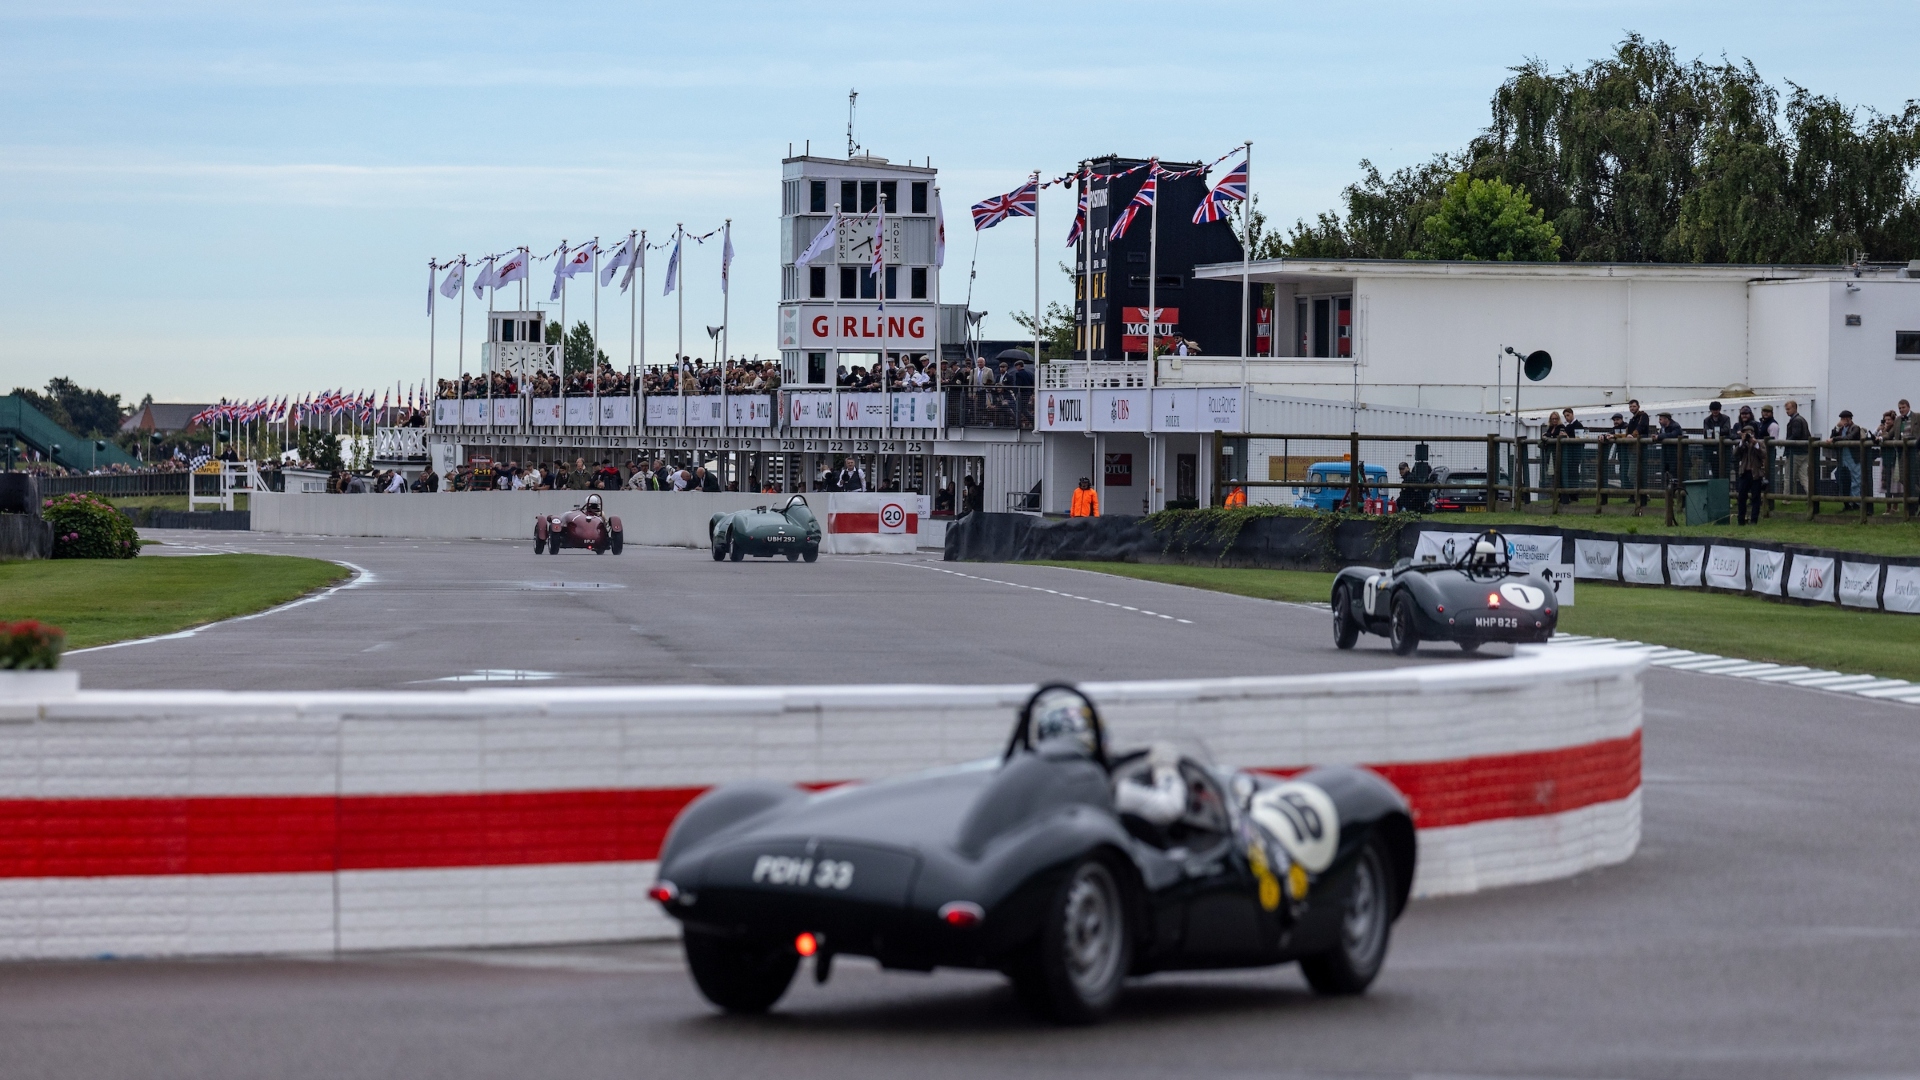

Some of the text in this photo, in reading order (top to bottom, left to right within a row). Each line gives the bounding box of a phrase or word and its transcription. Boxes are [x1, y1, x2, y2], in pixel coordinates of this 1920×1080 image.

[817, 402, 832, 418] RANDO
[1060, 399, 1082, 421] MOTUL
[1118, 400, 1129, 420] UBS
[610, 438, 619, 446] 12
[658, 439, 667, 447] 15
[719, 440, 729, 448] 18
[741, 440, 751, 448] 19
[782, 441, 794, 449] 20
[807, 441, 817, 450] 21
[831, 442, 843, 451] 22
[856, 442, 868, 451] 23
[882, 442, 895, 451] 24
[908, 442, 921, 452] 25
[1104, 466, 1129, 474] OTUL
[885, 510, 901, 521] 20
[1808, 568, 1823, 588] UBS
[1512, 587, 1530, 603] 7
[1475, 617, 1518, 628] MHP 825
[814, 859, 855, 890] 33
